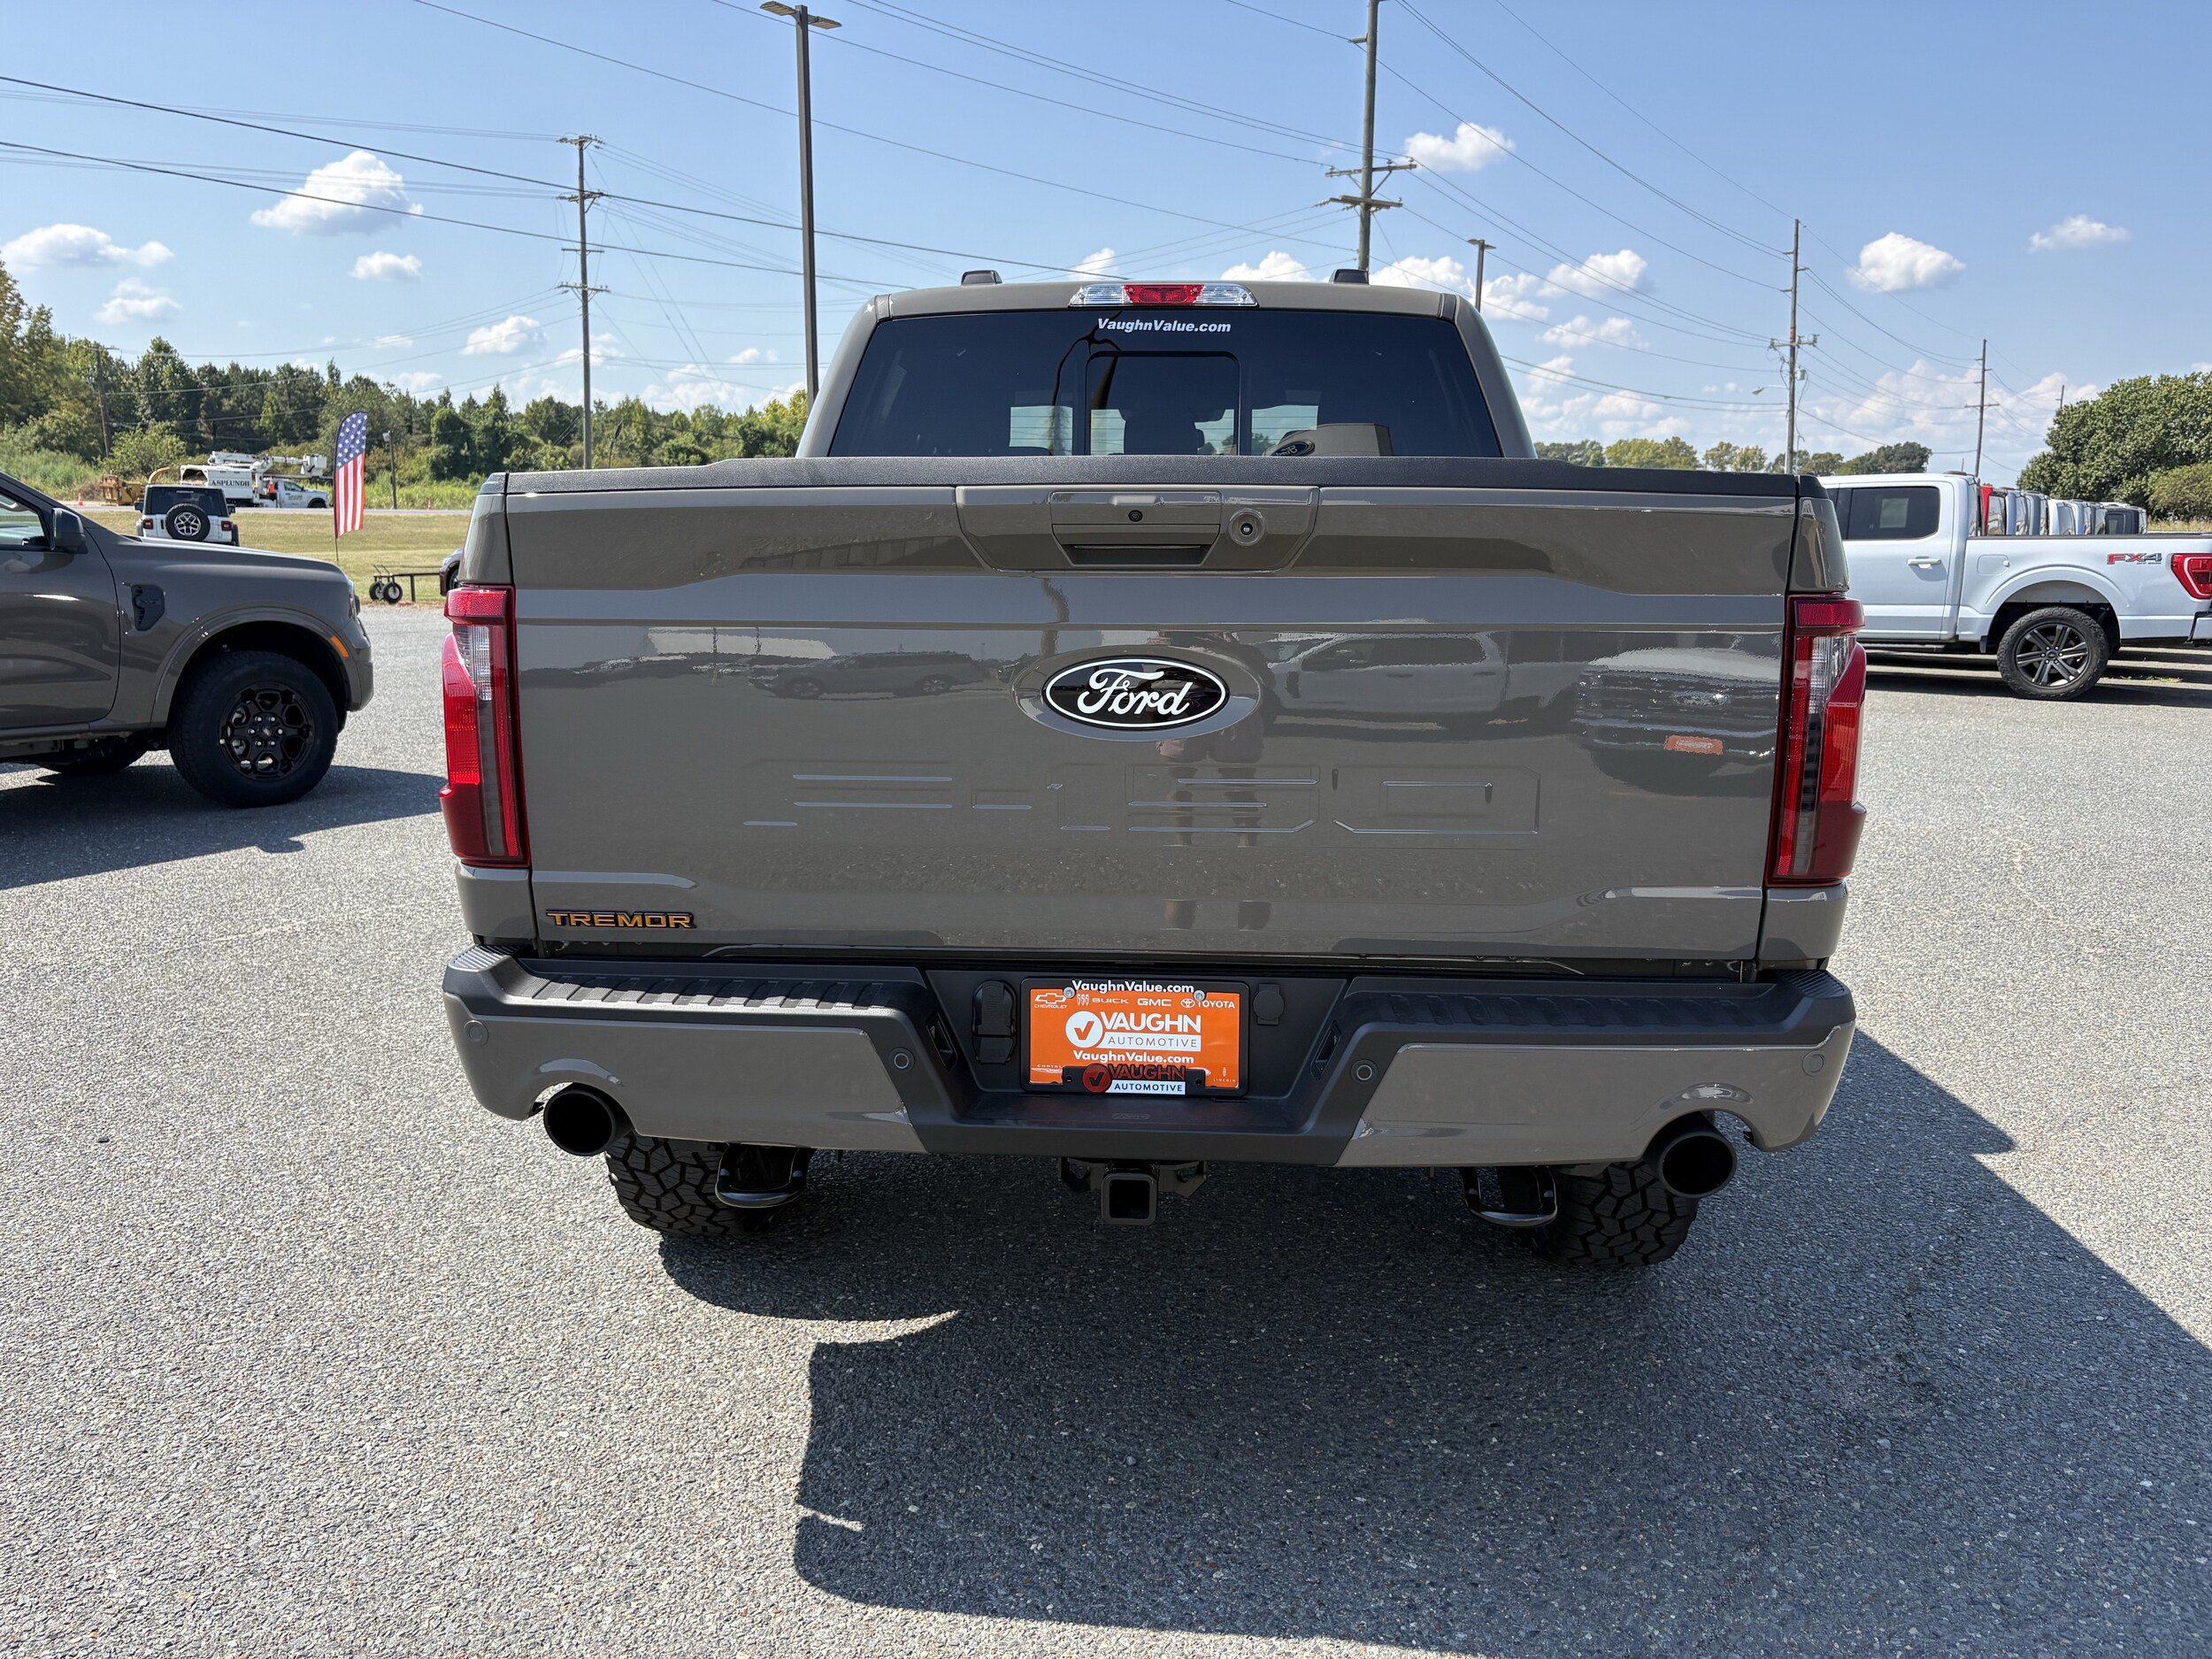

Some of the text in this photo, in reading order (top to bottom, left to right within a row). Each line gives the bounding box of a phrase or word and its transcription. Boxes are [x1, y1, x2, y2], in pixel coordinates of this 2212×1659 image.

[1097, 318, 1232, 334] VaughnValue.com
[2107, 553, 2162, 565] FX4
[1077, 668, 1193, 715] Ford
[545, 910, 696, 928] TREMOR
[1071, 979, 1194, 995] VaughnValue.com
[1137, 998, 1172, 1007] GMC
[1100, 1011, 1202, 1033] VAUGHN
[1108, 1036, 1197, 1048] AUTOMOTIVE
[1073, 1050, 1194, 1064] VaughnValue.com
[1107, 1064, 1186, 1080] VAUGHN
[1114, 1083, 1183, 1092] AUTOMOTIVE
